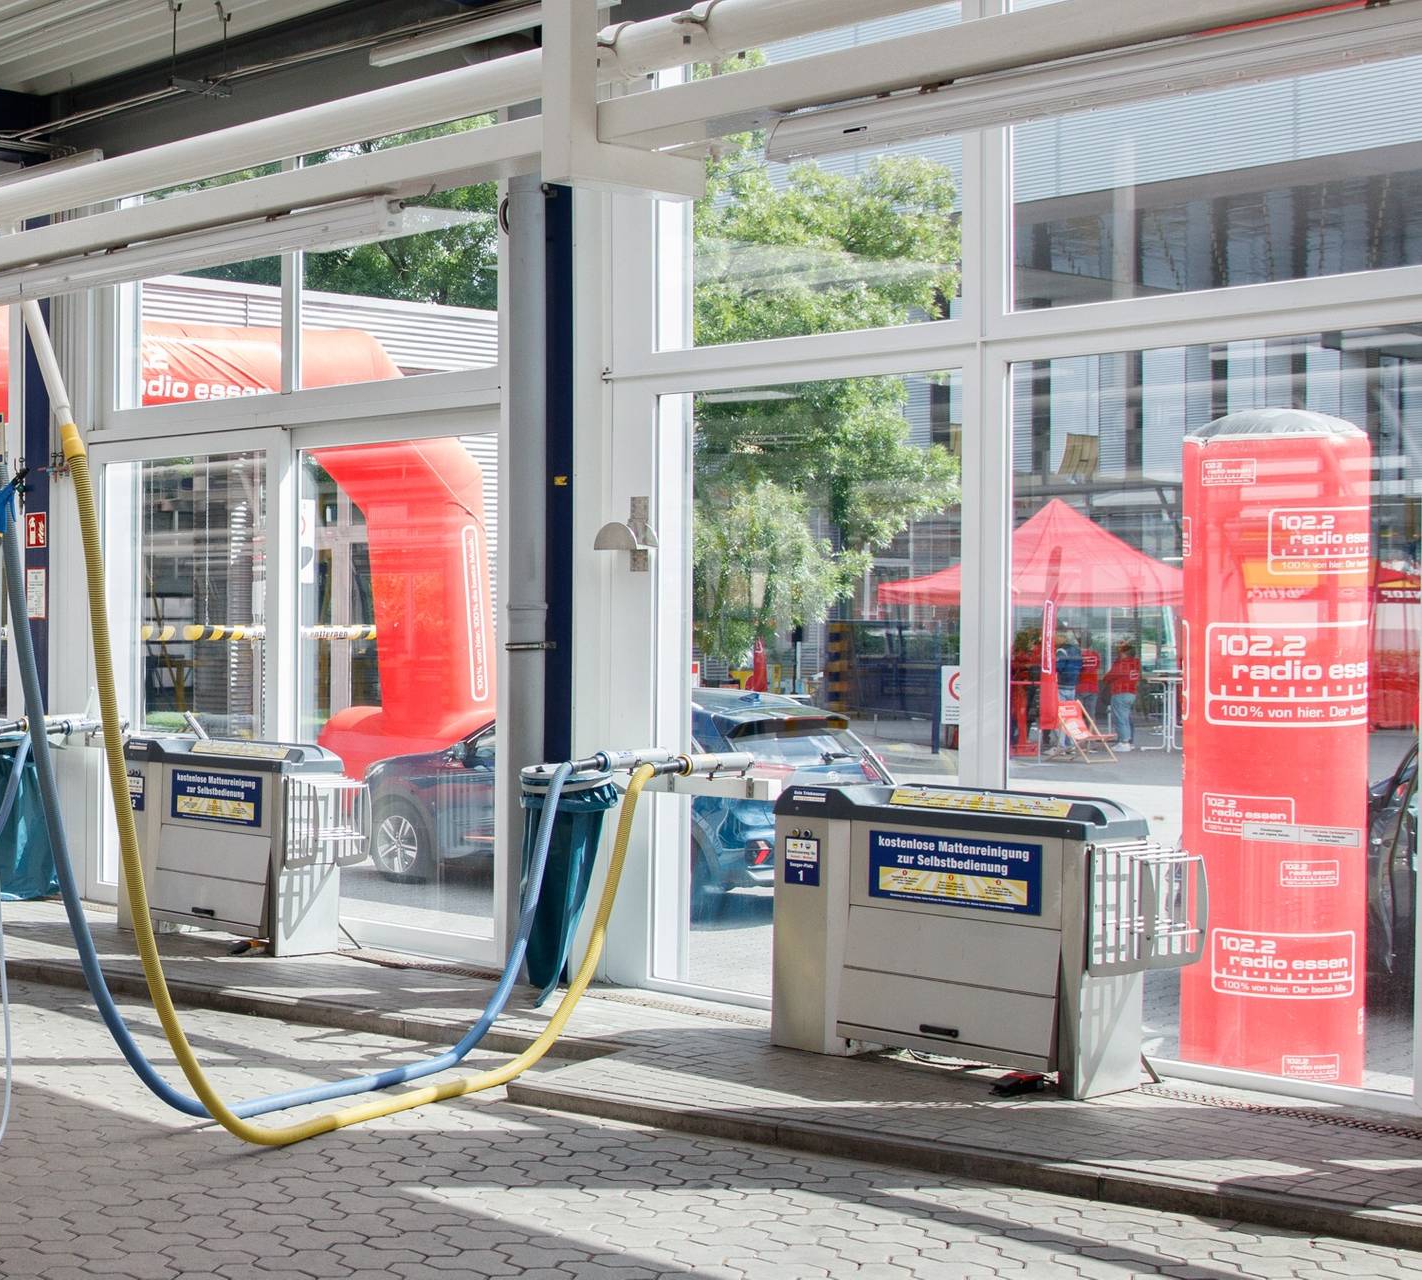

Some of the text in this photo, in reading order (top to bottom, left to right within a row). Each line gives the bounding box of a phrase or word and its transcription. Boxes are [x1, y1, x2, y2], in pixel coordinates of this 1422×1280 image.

[142, 375, 189, 398] dio
[1279, 515, 1335, 530] 102.2
[1290, 531, 1343, 545] radio
[1217, 635, 1307, 657] 102.2
[1232, 660, 1368, 681] radio ess
[1268, 708, 1292, 718] von
[1297, 706, 1325, 718] hier.
[1329, 706, 1349, 717] Der
[177, 773, 256, 790] kostenlose Mattenreinigung
[197, 785, 245, 800] Selbstbedienung
[1207, 797, 1237, 809] 102.2
[1211, 808, 1287, 820] radio essen
[878, 835, 1030, 862] kostenlose Mattenreinigung
[897, 854, 1008, 876] zur Selbstbedienung
[798, 870, 804, 881] 1
[1220, 936, 1276, 954] 102.2
[1229, 955, 1348, 970] radio essen
[1252, 984, 1267, 992] von
[1270, 984, 1289, 993] hier.
[1292, 985, 1309, 993] Der
[1311, 985, 1333, 993] beste
